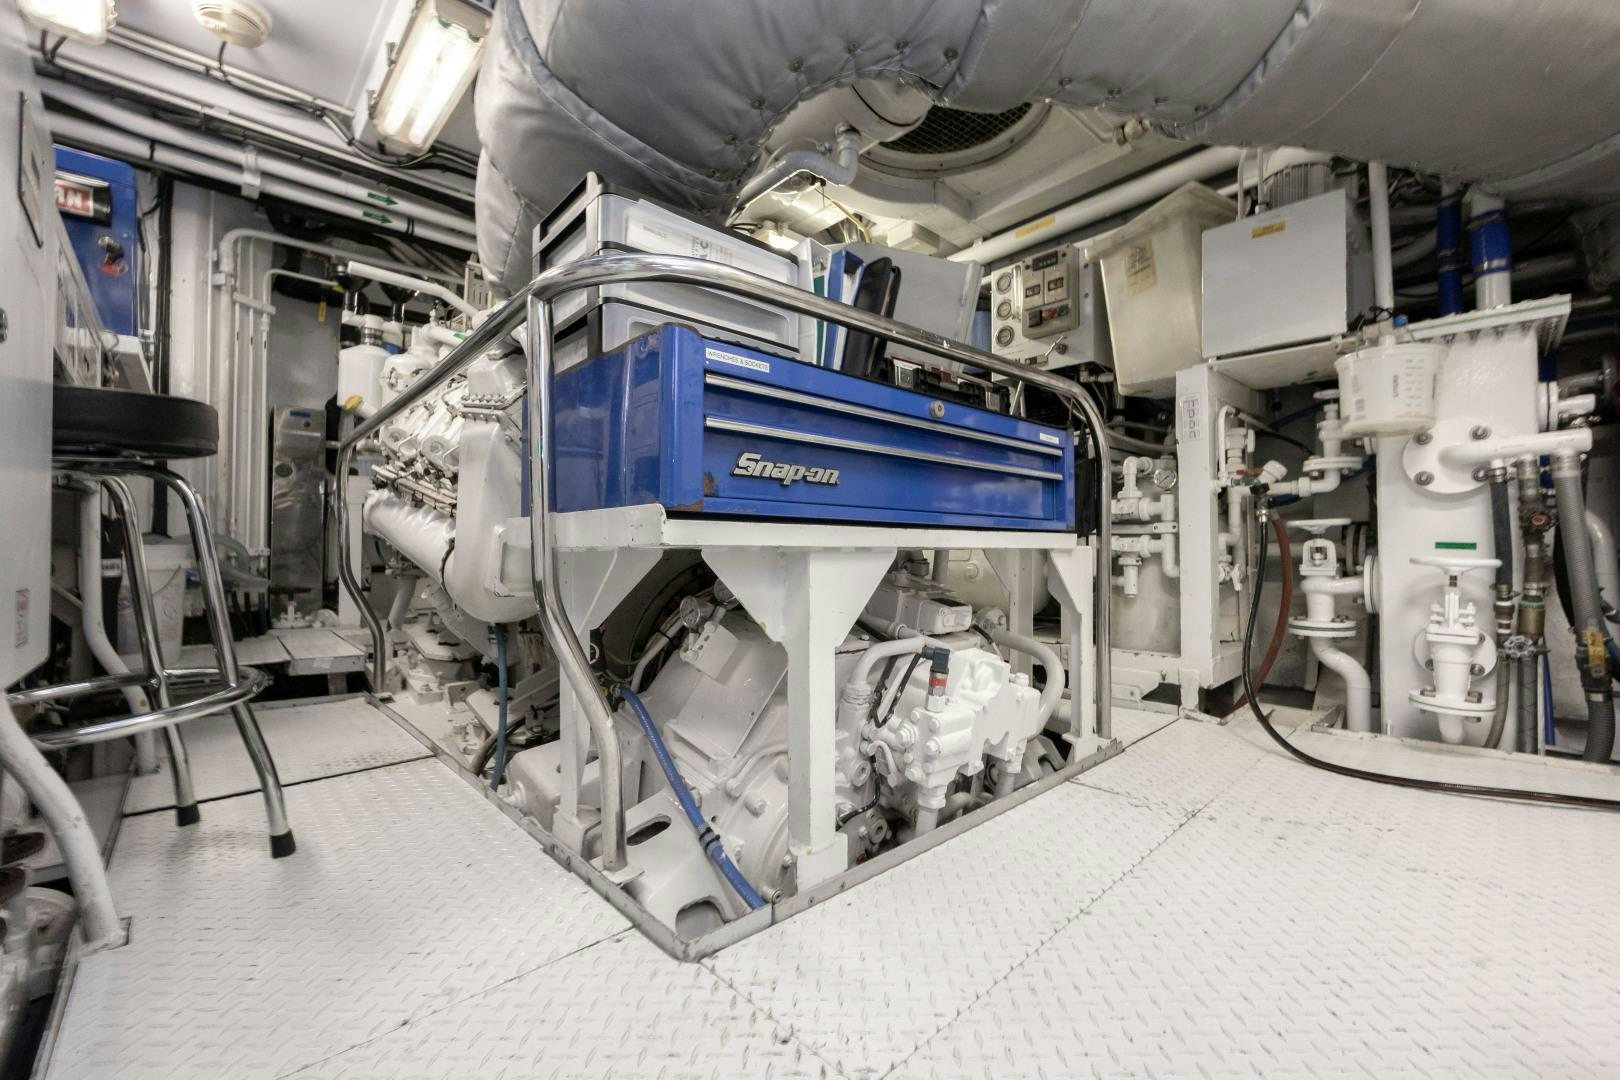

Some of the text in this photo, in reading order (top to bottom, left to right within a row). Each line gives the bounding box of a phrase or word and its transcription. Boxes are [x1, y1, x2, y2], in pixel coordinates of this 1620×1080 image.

[708, 351, 738, 363] WRENCHES
[745, 360, 769, 371] SOCKETS
[733, 452, 839, 486] Snap-on
